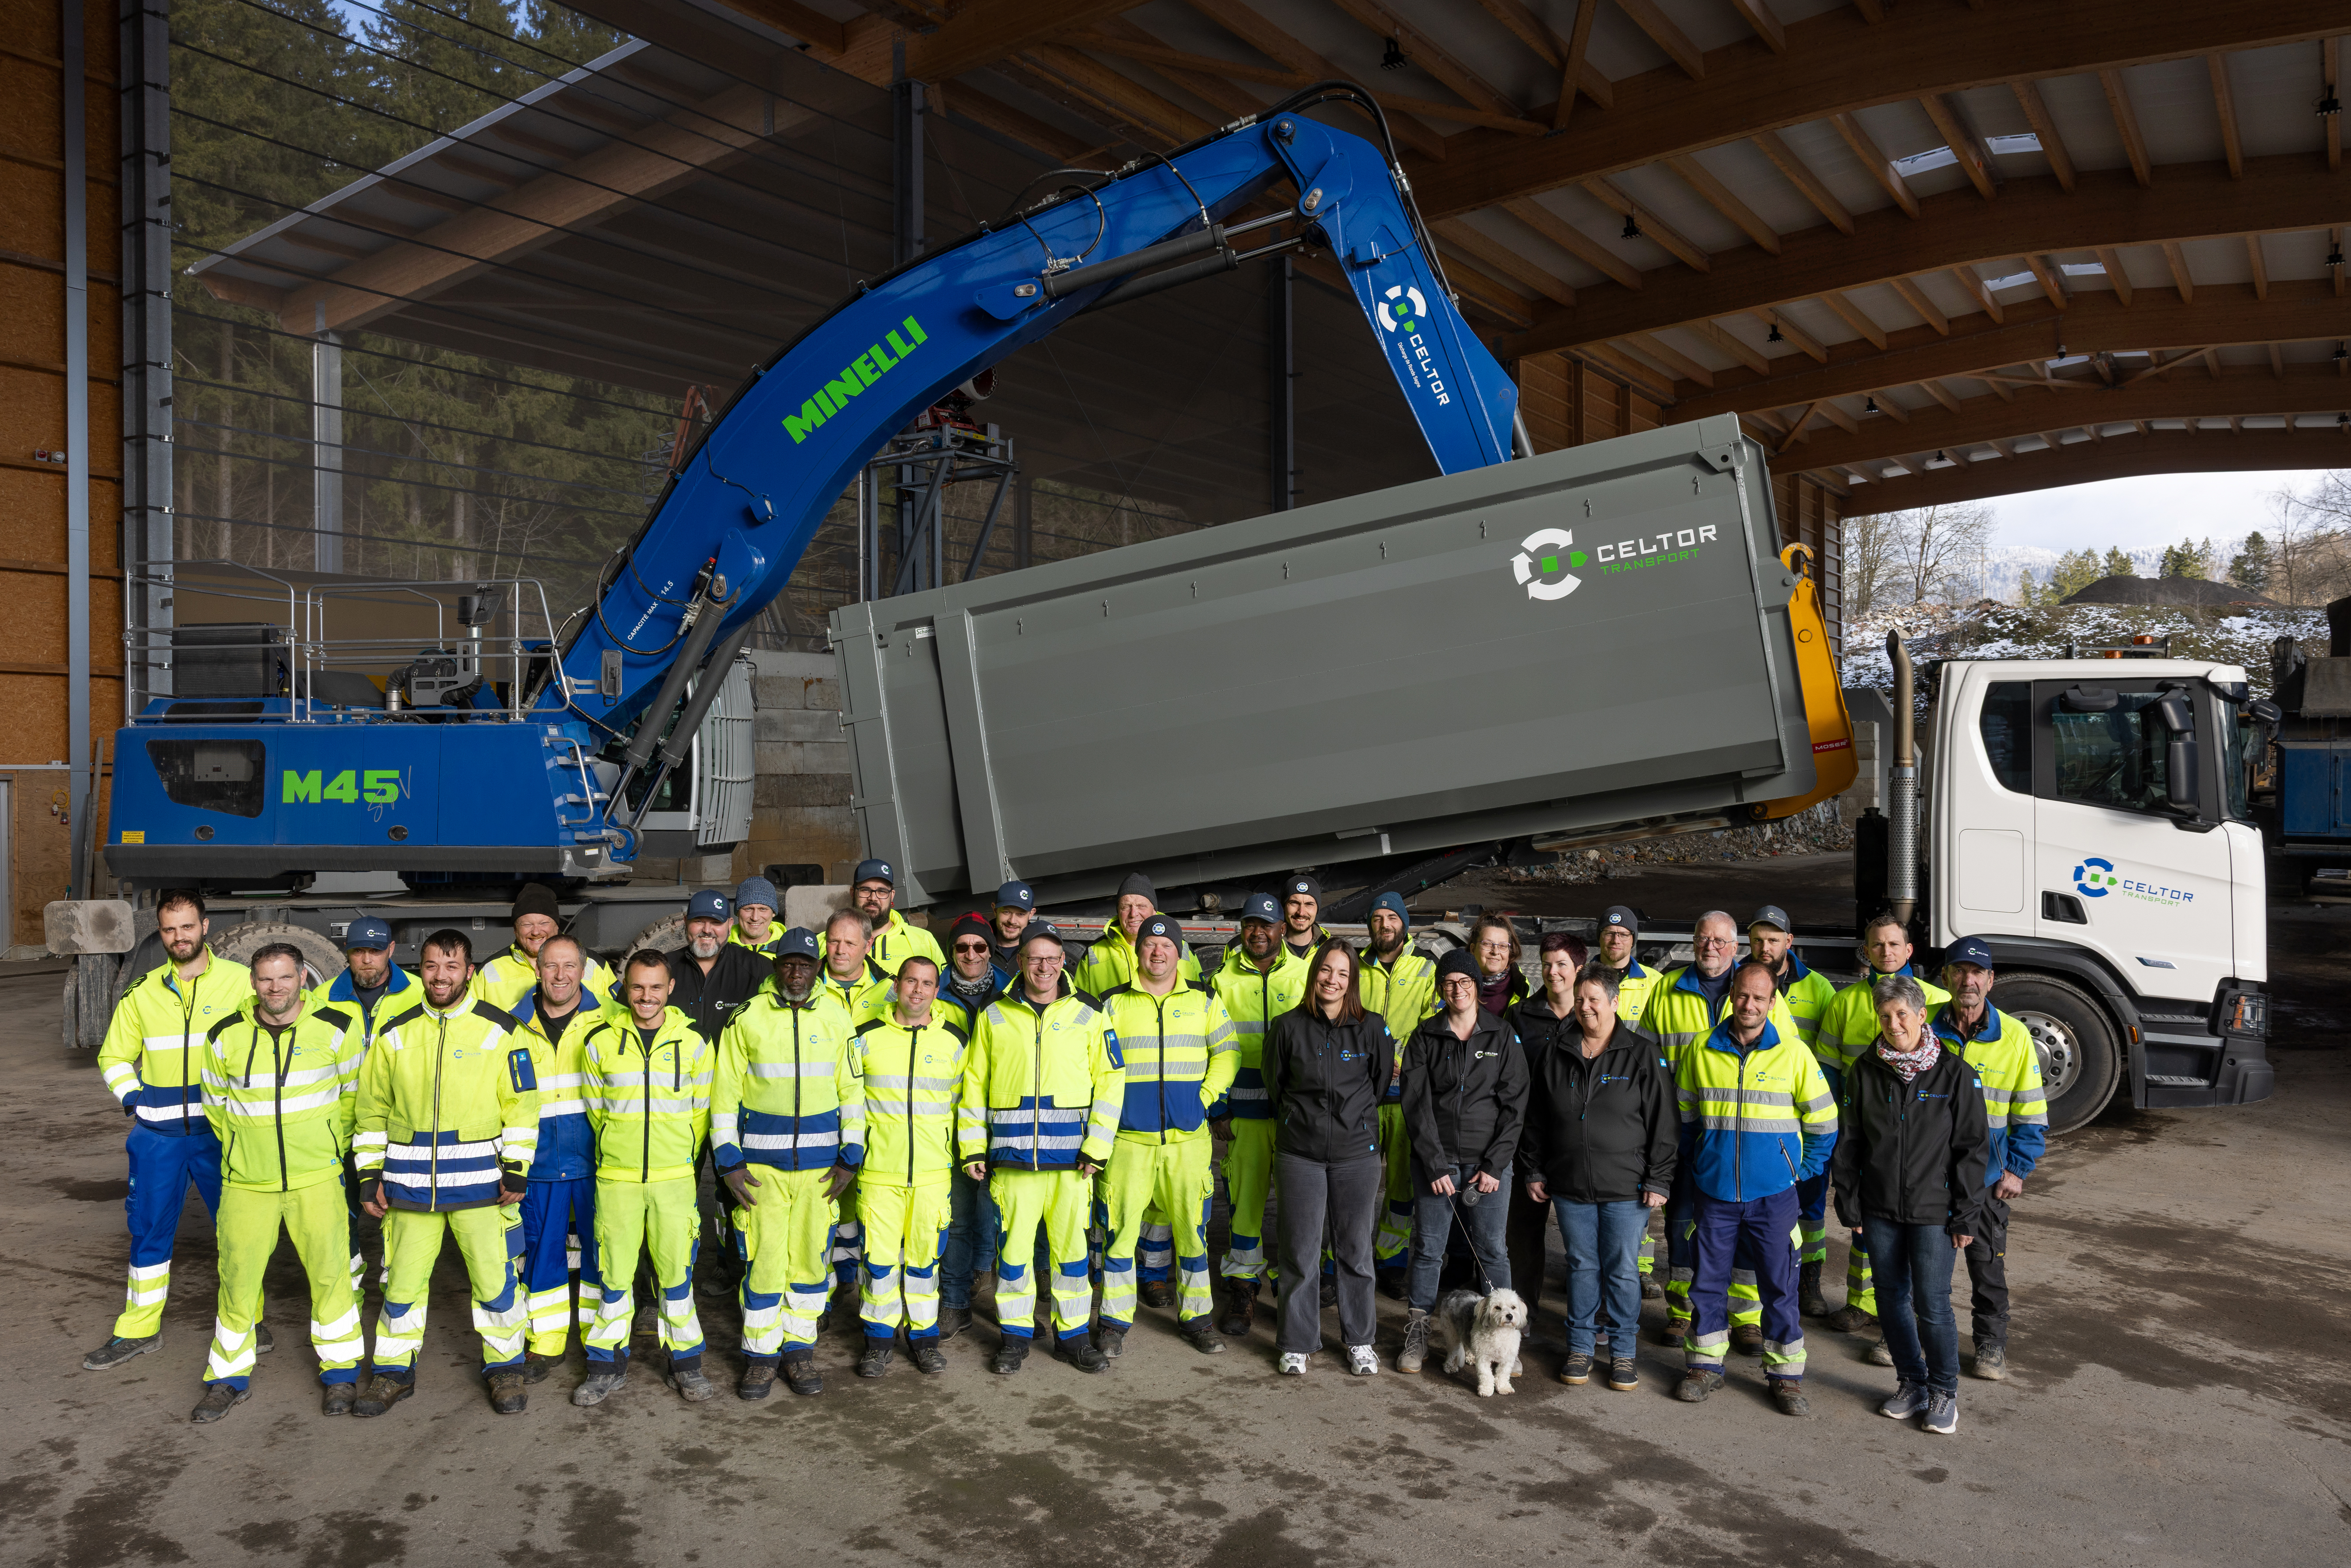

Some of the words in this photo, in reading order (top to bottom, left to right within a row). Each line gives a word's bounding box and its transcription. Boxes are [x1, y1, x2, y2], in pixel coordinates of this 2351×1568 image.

[1398, 342, 1408, 359] Décharge
[782, 315, 928, 444] MINELLI
[1410, 334, 1450, 406] CELTOR
[1597, 524, 1717, 562] CELTOR
[1600, 548, 1700, 575] TRANSPORT
[628, 613, 649, 640] CAPACITÉ
[647, 601, 658, 615] MAX
[661, 580, 673, 595] 14.5
[1815, 741, 1846, 750] MOSER
[283, 770, 400, 803] M45
[368, 783, 401, 822] Stage
[1330, 890, 1369, 911] MOSER
[1371, 856, 1442, 892] LOADSYSTEM
[2122, 890, 2180, 907] TRANSPORT
[2123, 879, 2194, 902] CELTOR
